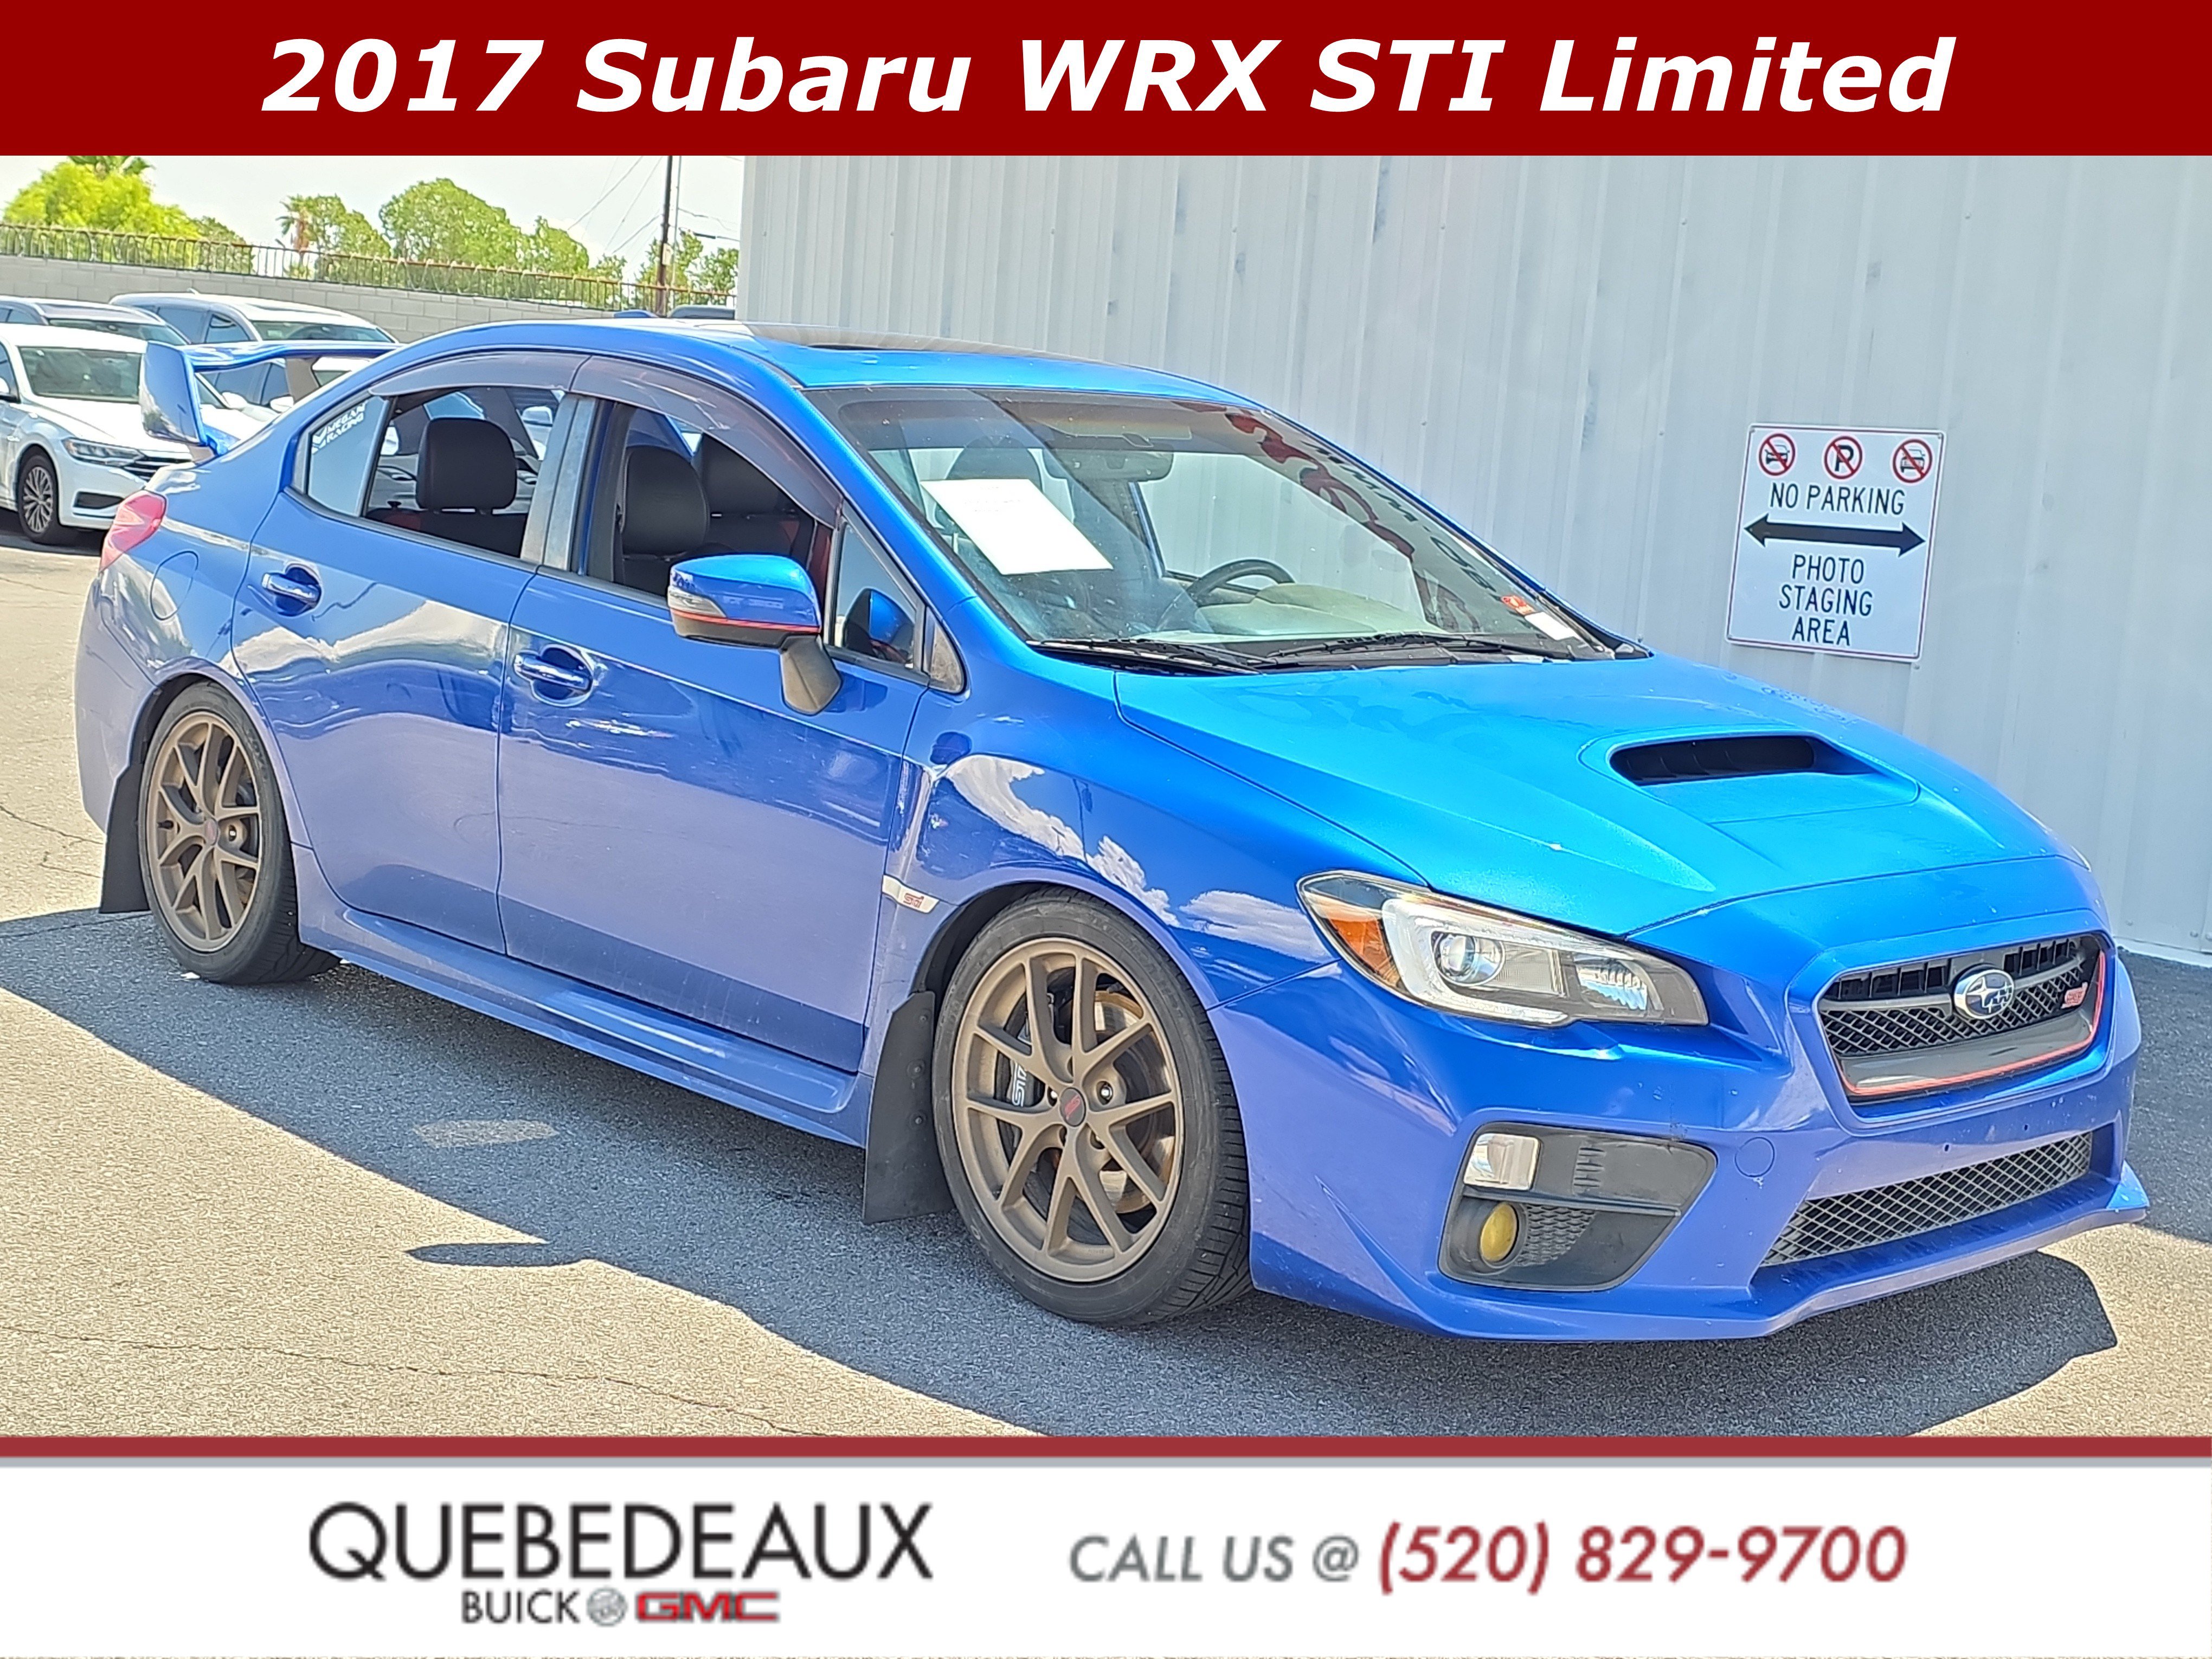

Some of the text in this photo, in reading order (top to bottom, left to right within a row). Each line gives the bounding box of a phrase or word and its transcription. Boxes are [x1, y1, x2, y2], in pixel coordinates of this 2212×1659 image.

[326, 412, 364, 443] RACING
[1770, 482, 1906, 515] NO PARKING
[1791, 554, 1864, 584] PHOTO
[1778, 584, 1873, 616] STAGING
[1791, 616, 1851, 646] AREA
